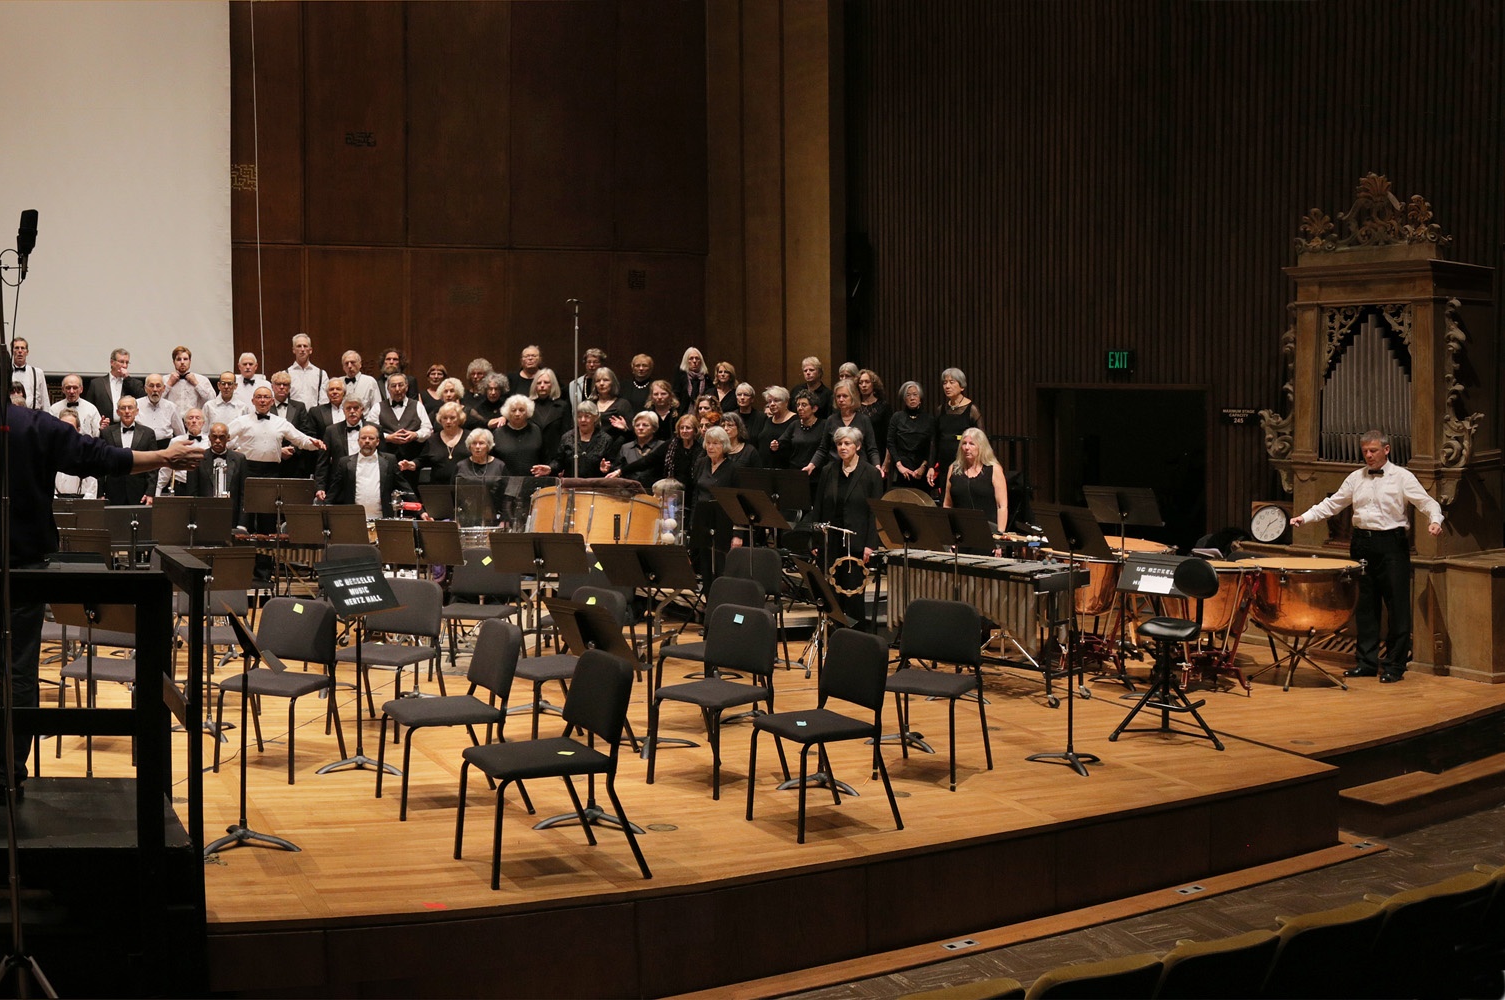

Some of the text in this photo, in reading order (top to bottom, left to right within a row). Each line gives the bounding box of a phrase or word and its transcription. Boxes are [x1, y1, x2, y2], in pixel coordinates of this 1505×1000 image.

[1108, 351, 1129, 369] EXIT
[1148, 567, 1174, 575] BERKEL
[333, 575, 376, 588] UC BERKELEY
[348, 586, 370, 596] MUSIC
[344, 594, 383, 606] HERTZ HALL
